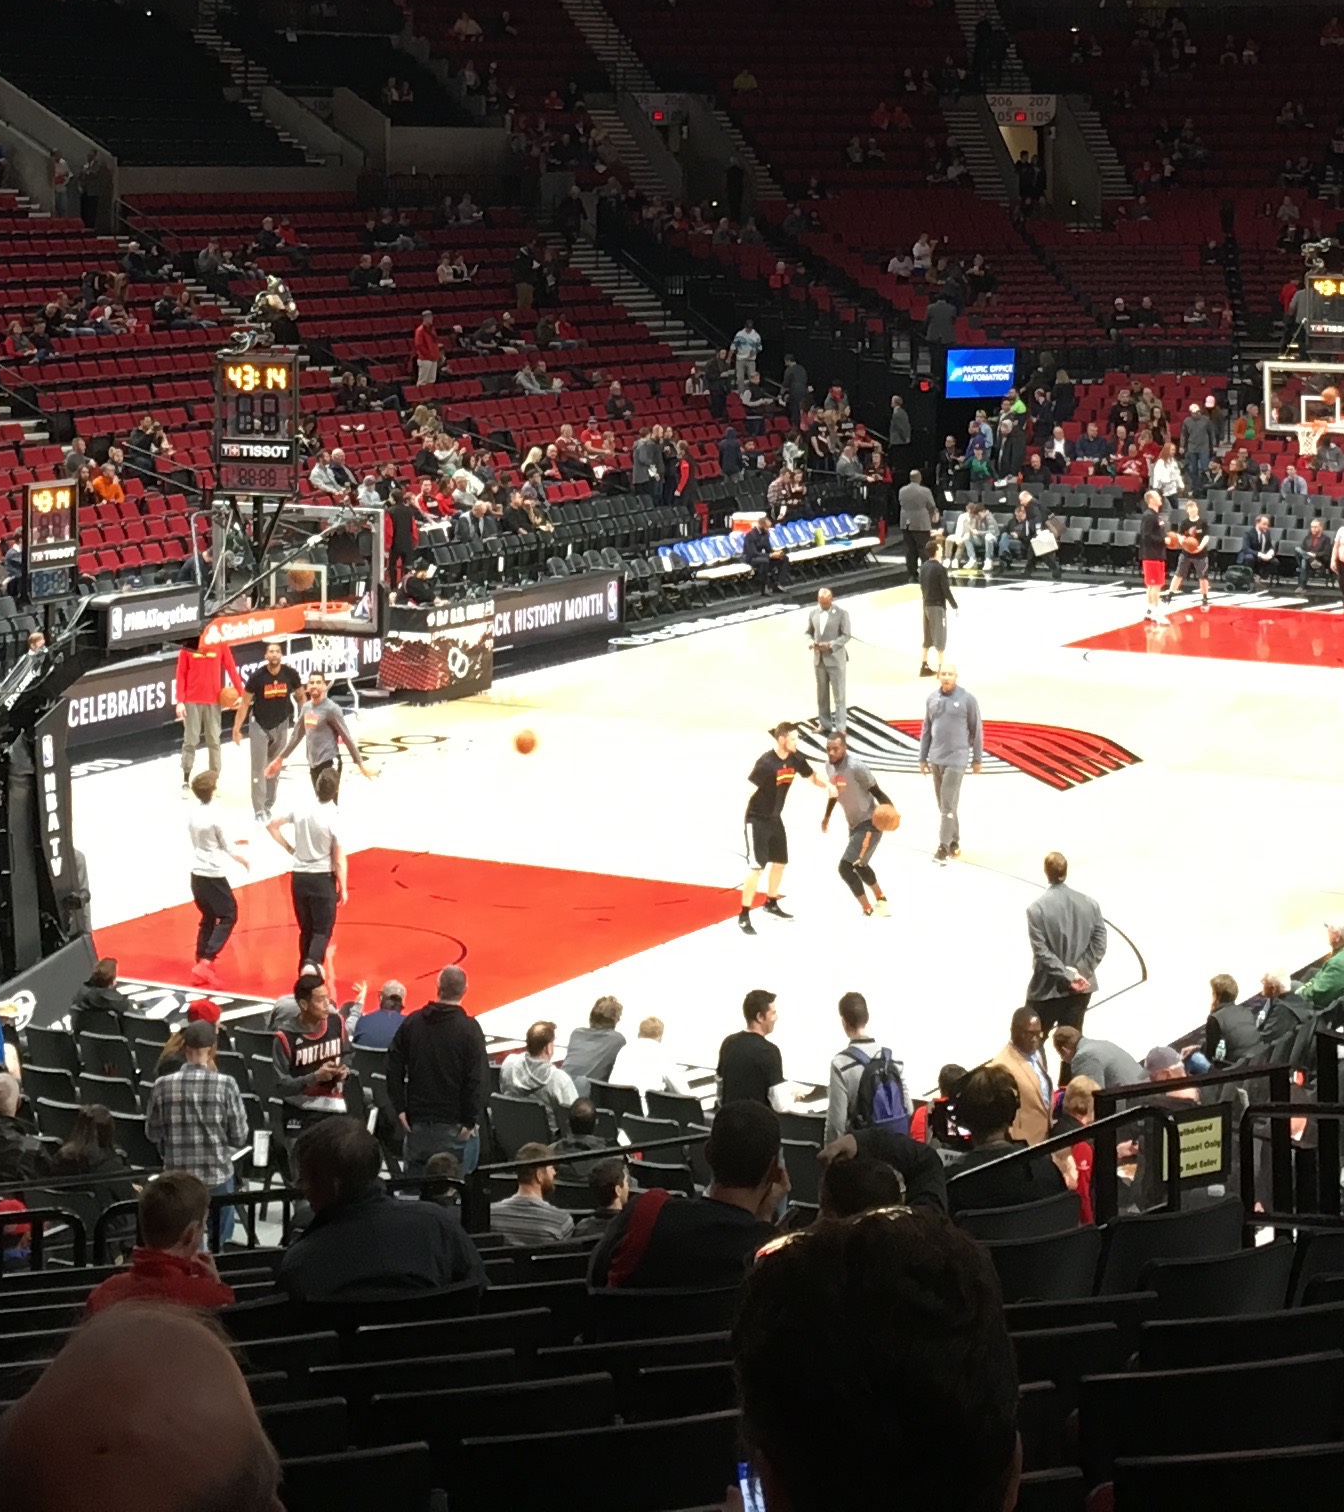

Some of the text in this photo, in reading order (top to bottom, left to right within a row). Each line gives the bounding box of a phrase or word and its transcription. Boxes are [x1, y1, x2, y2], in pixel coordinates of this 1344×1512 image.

[990, 96, 1013, 107] 206
[1028, 96, 1051, 107] 207
[227, 364, 287, 391] 43:14
[239, 444, 290, 459] TISSOT
[514, 601, 561, 633] HISTORY
[564, 592, 604, 621] MONTH
[67, 681, 167, 728] CELEBRATES
[1179, 1122, 1214, 1140] uthorized
[1203, 1137, 1222, 1152] Only
[1185, 1155, 1219, 1172] Not Enter
